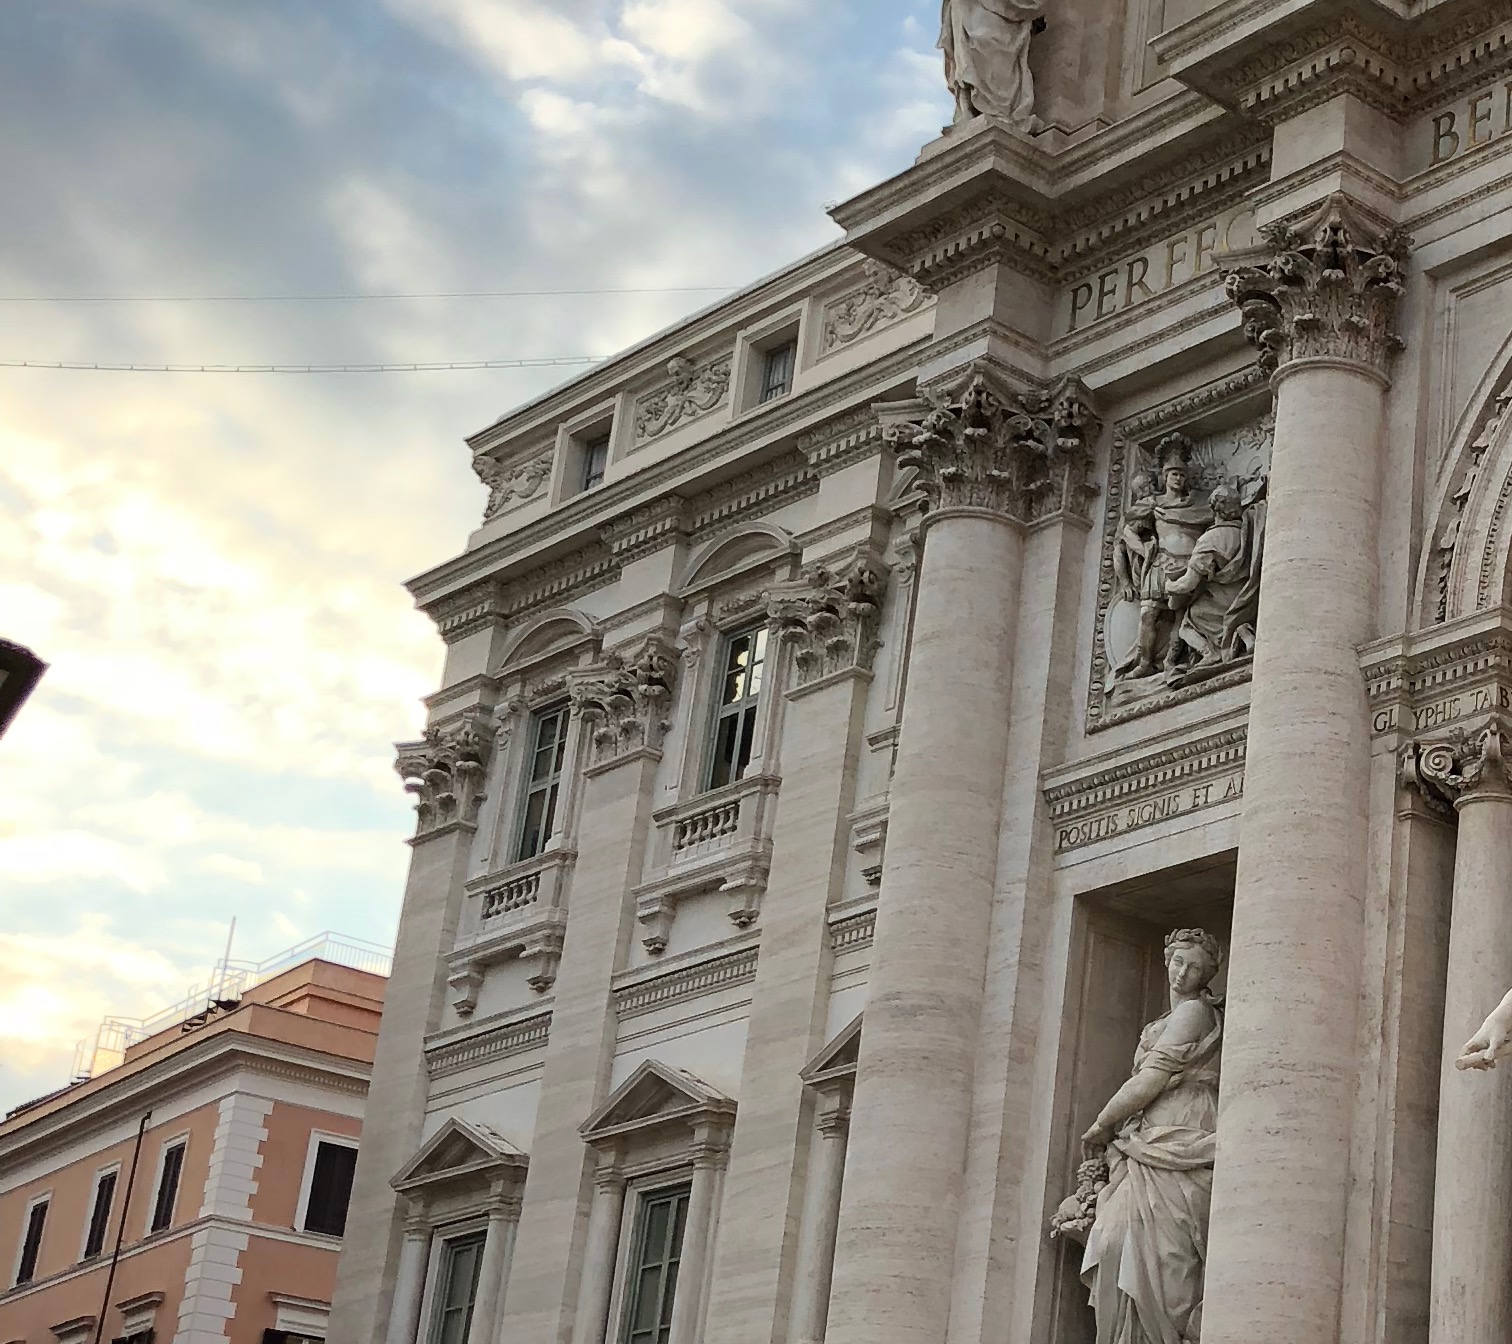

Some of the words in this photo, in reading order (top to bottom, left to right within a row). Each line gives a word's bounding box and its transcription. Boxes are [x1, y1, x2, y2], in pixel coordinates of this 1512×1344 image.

[1058, 813, 1119, 849] POSITIS
[1126, 794, 1180, 828] SIGNIS
[1191, 783, 1213, 808] ET
